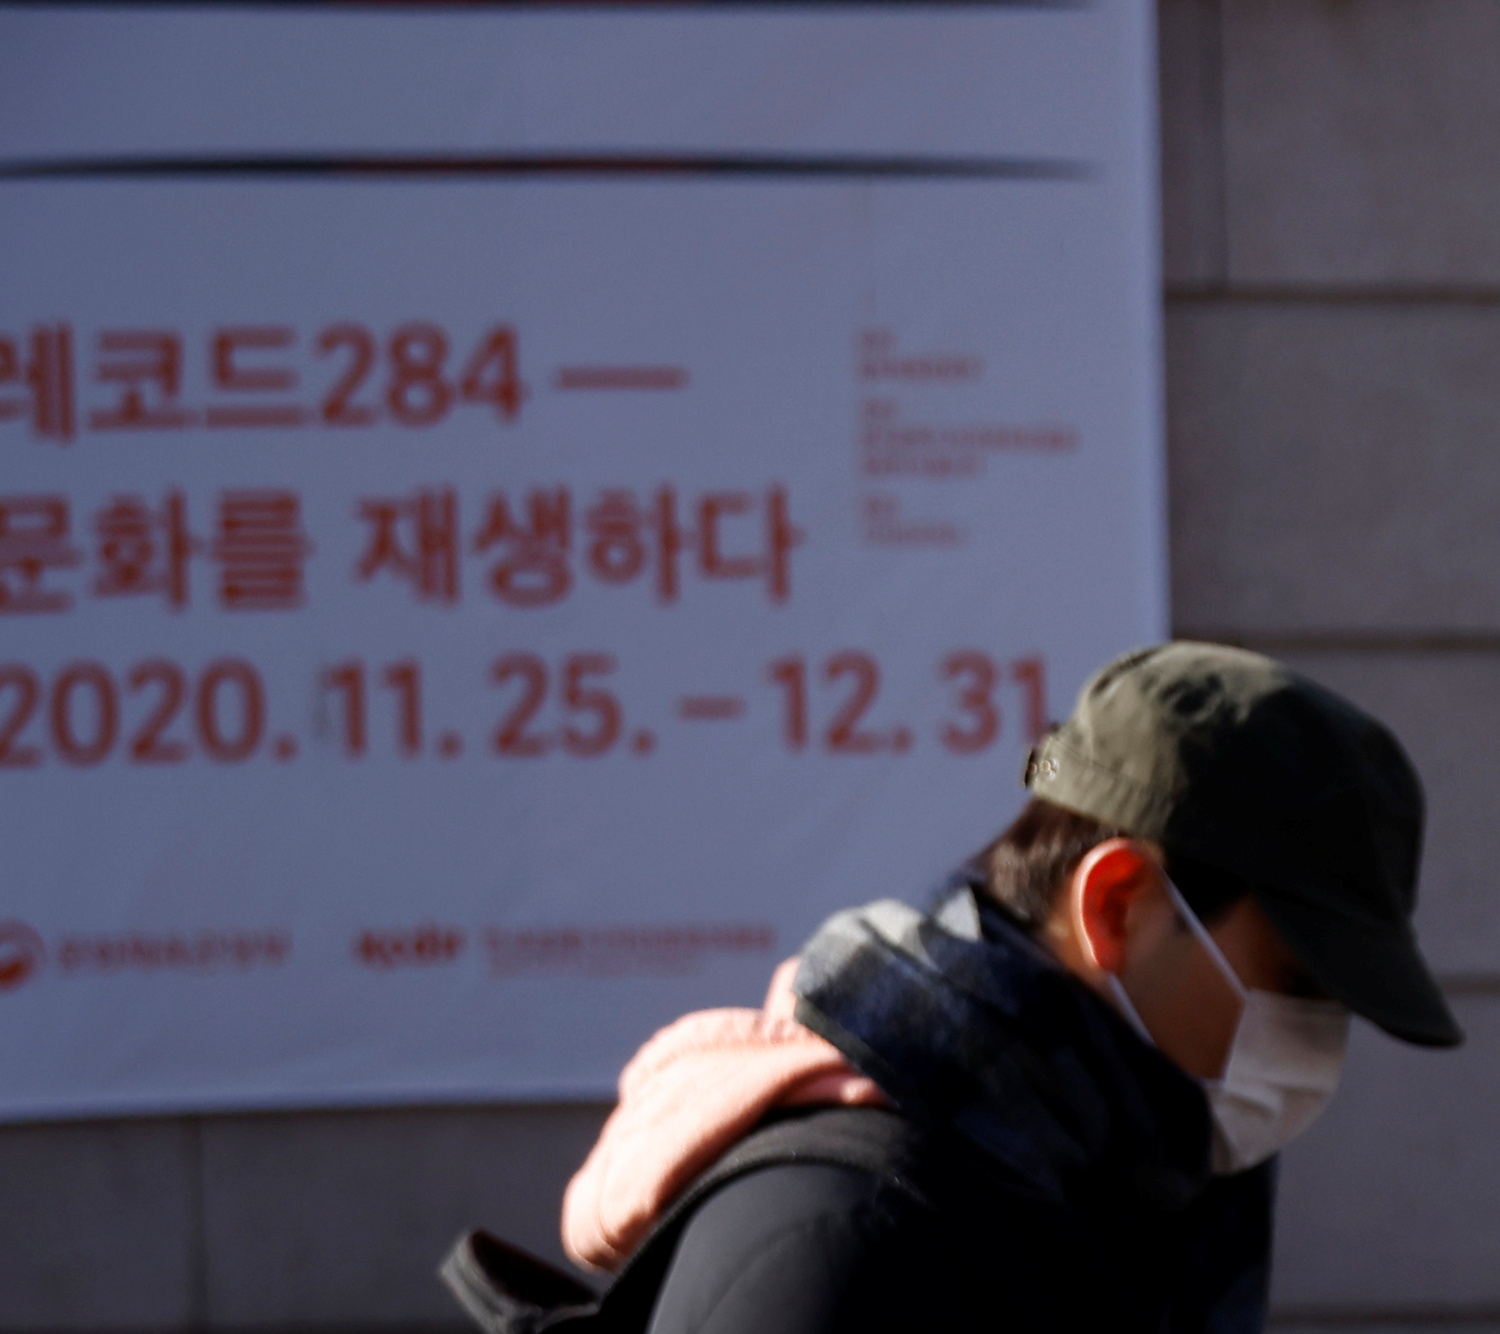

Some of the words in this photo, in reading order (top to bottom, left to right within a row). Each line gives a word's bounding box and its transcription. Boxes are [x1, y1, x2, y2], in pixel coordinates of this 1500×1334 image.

[0, 322, 525, 442] 레코드284
[0, 490, 309, 613] 문화를
[356, 485, 800, 607] 재생하다
